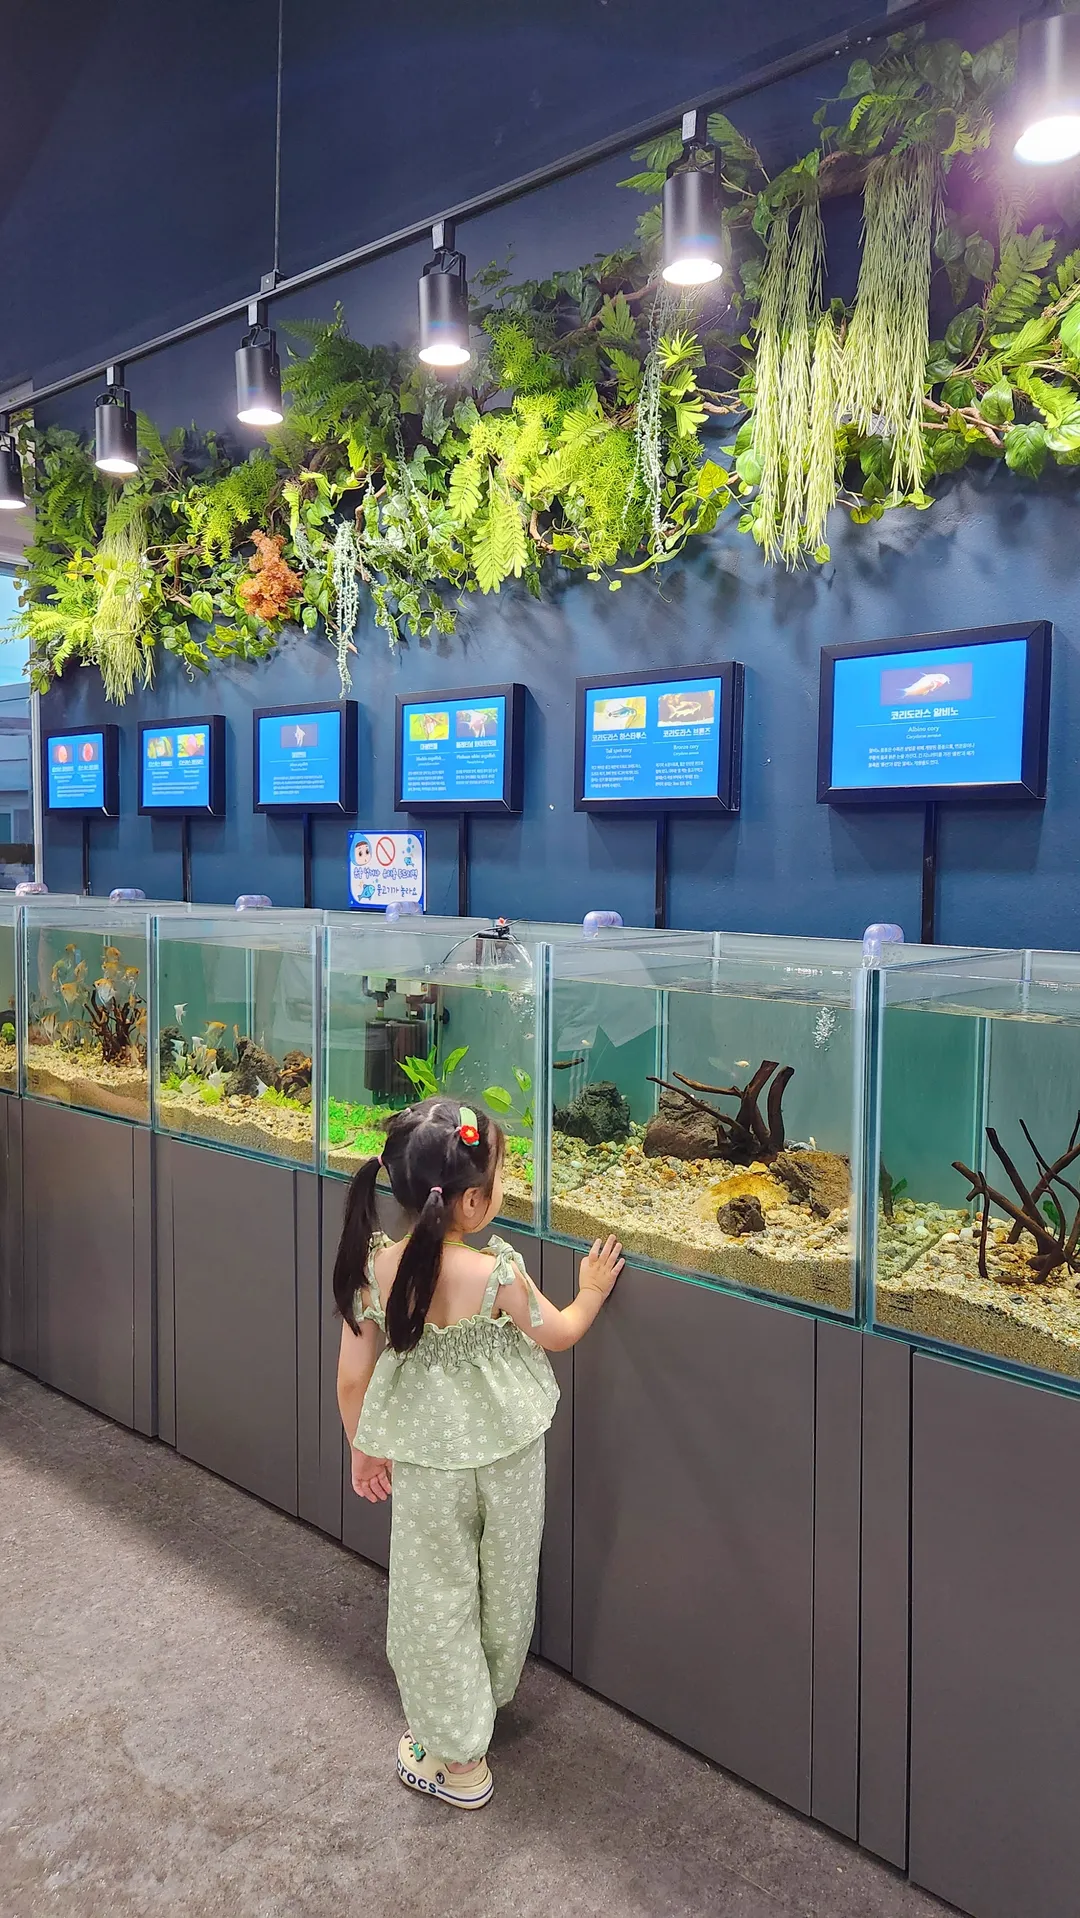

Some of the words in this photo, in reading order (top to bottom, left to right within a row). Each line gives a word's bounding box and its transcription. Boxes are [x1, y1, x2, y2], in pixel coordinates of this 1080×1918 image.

[891, 709, 931, 720] 코리도라스
[933, 707, 959, 717] 알비노
[592, 733, 618, 742] 코리도라스
[663, 729, 692, 737] 코리도라스
[377, 884, 399, 896] 물고기가
[401, 885, 417, 897] 놀라요
